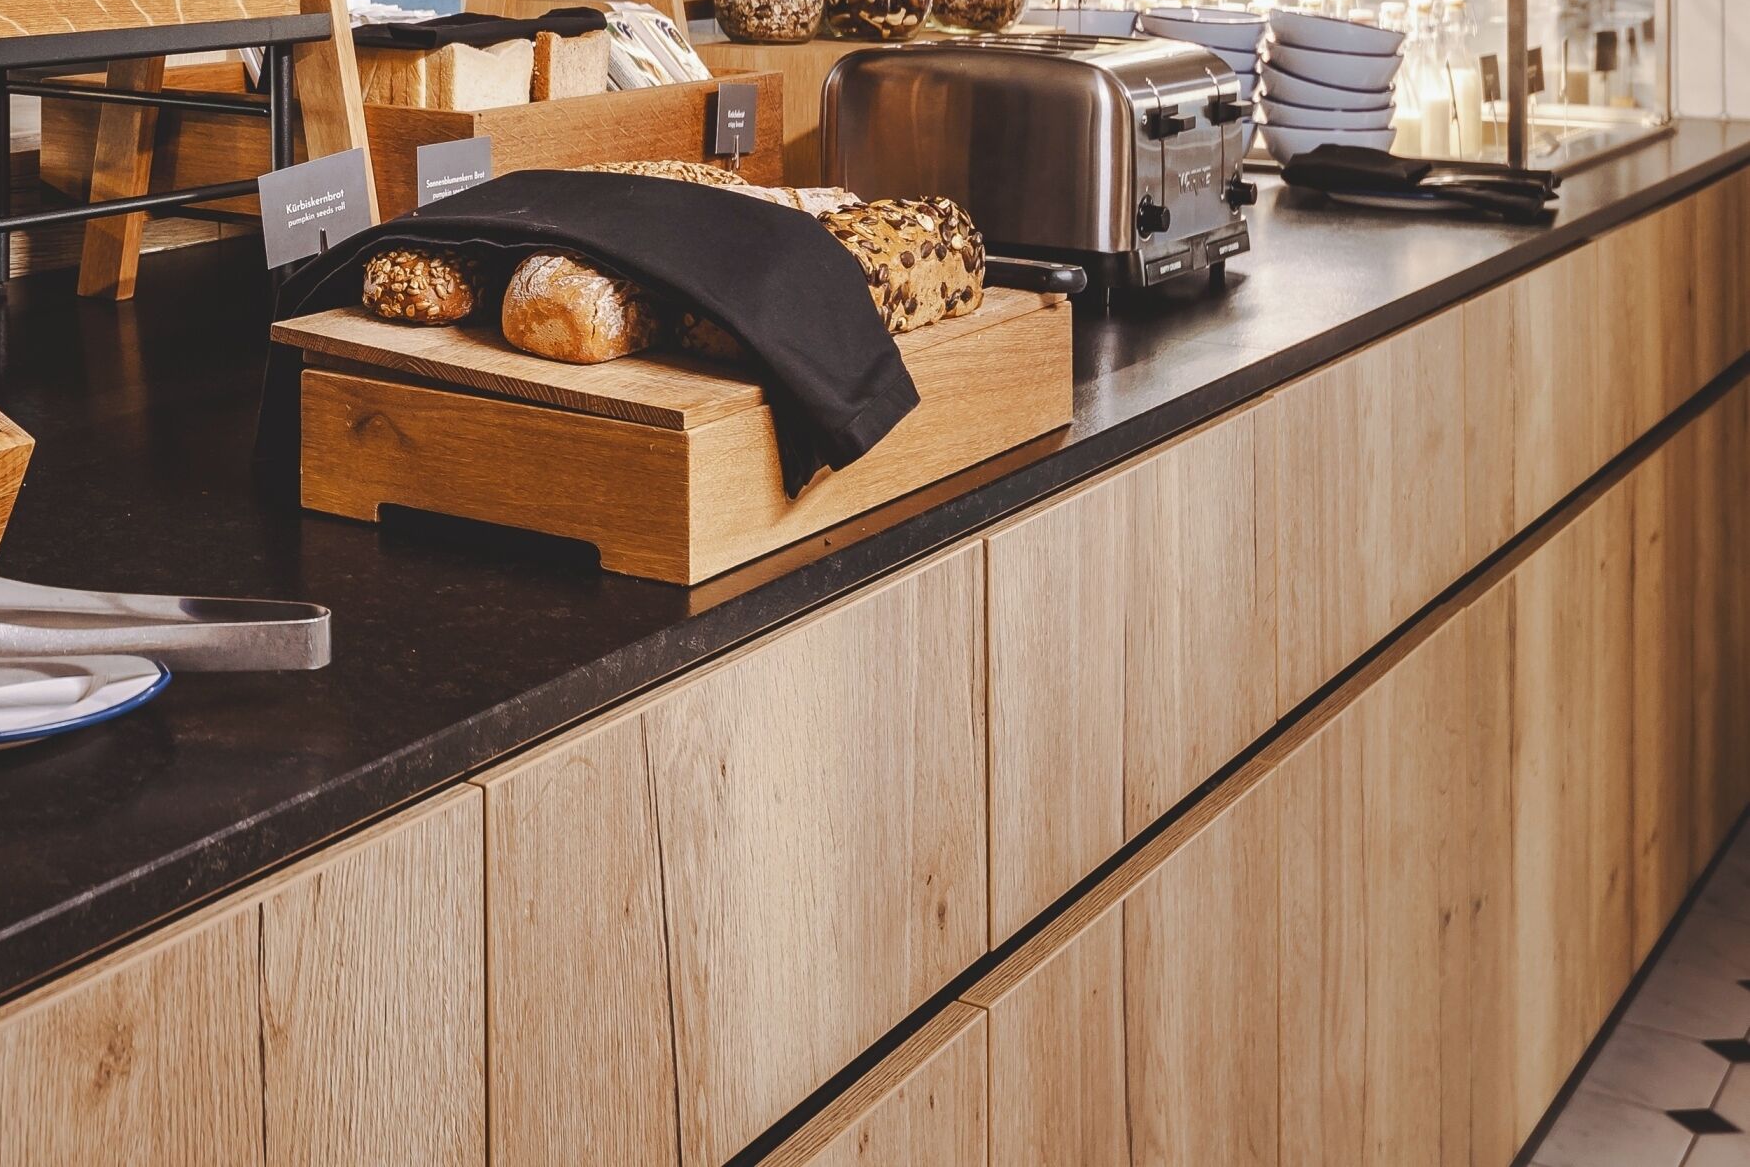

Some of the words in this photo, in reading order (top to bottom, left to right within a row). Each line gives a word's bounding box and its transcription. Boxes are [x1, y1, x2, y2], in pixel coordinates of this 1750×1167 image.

[474, 170, 485, 180] Brot
[286, 189, 345, 215] Kürbiskernbrot
[288, 212, 315, 229] pumpkin
[316, 205, 334, 218] seeds
[335, 201, 346, 212] roll
